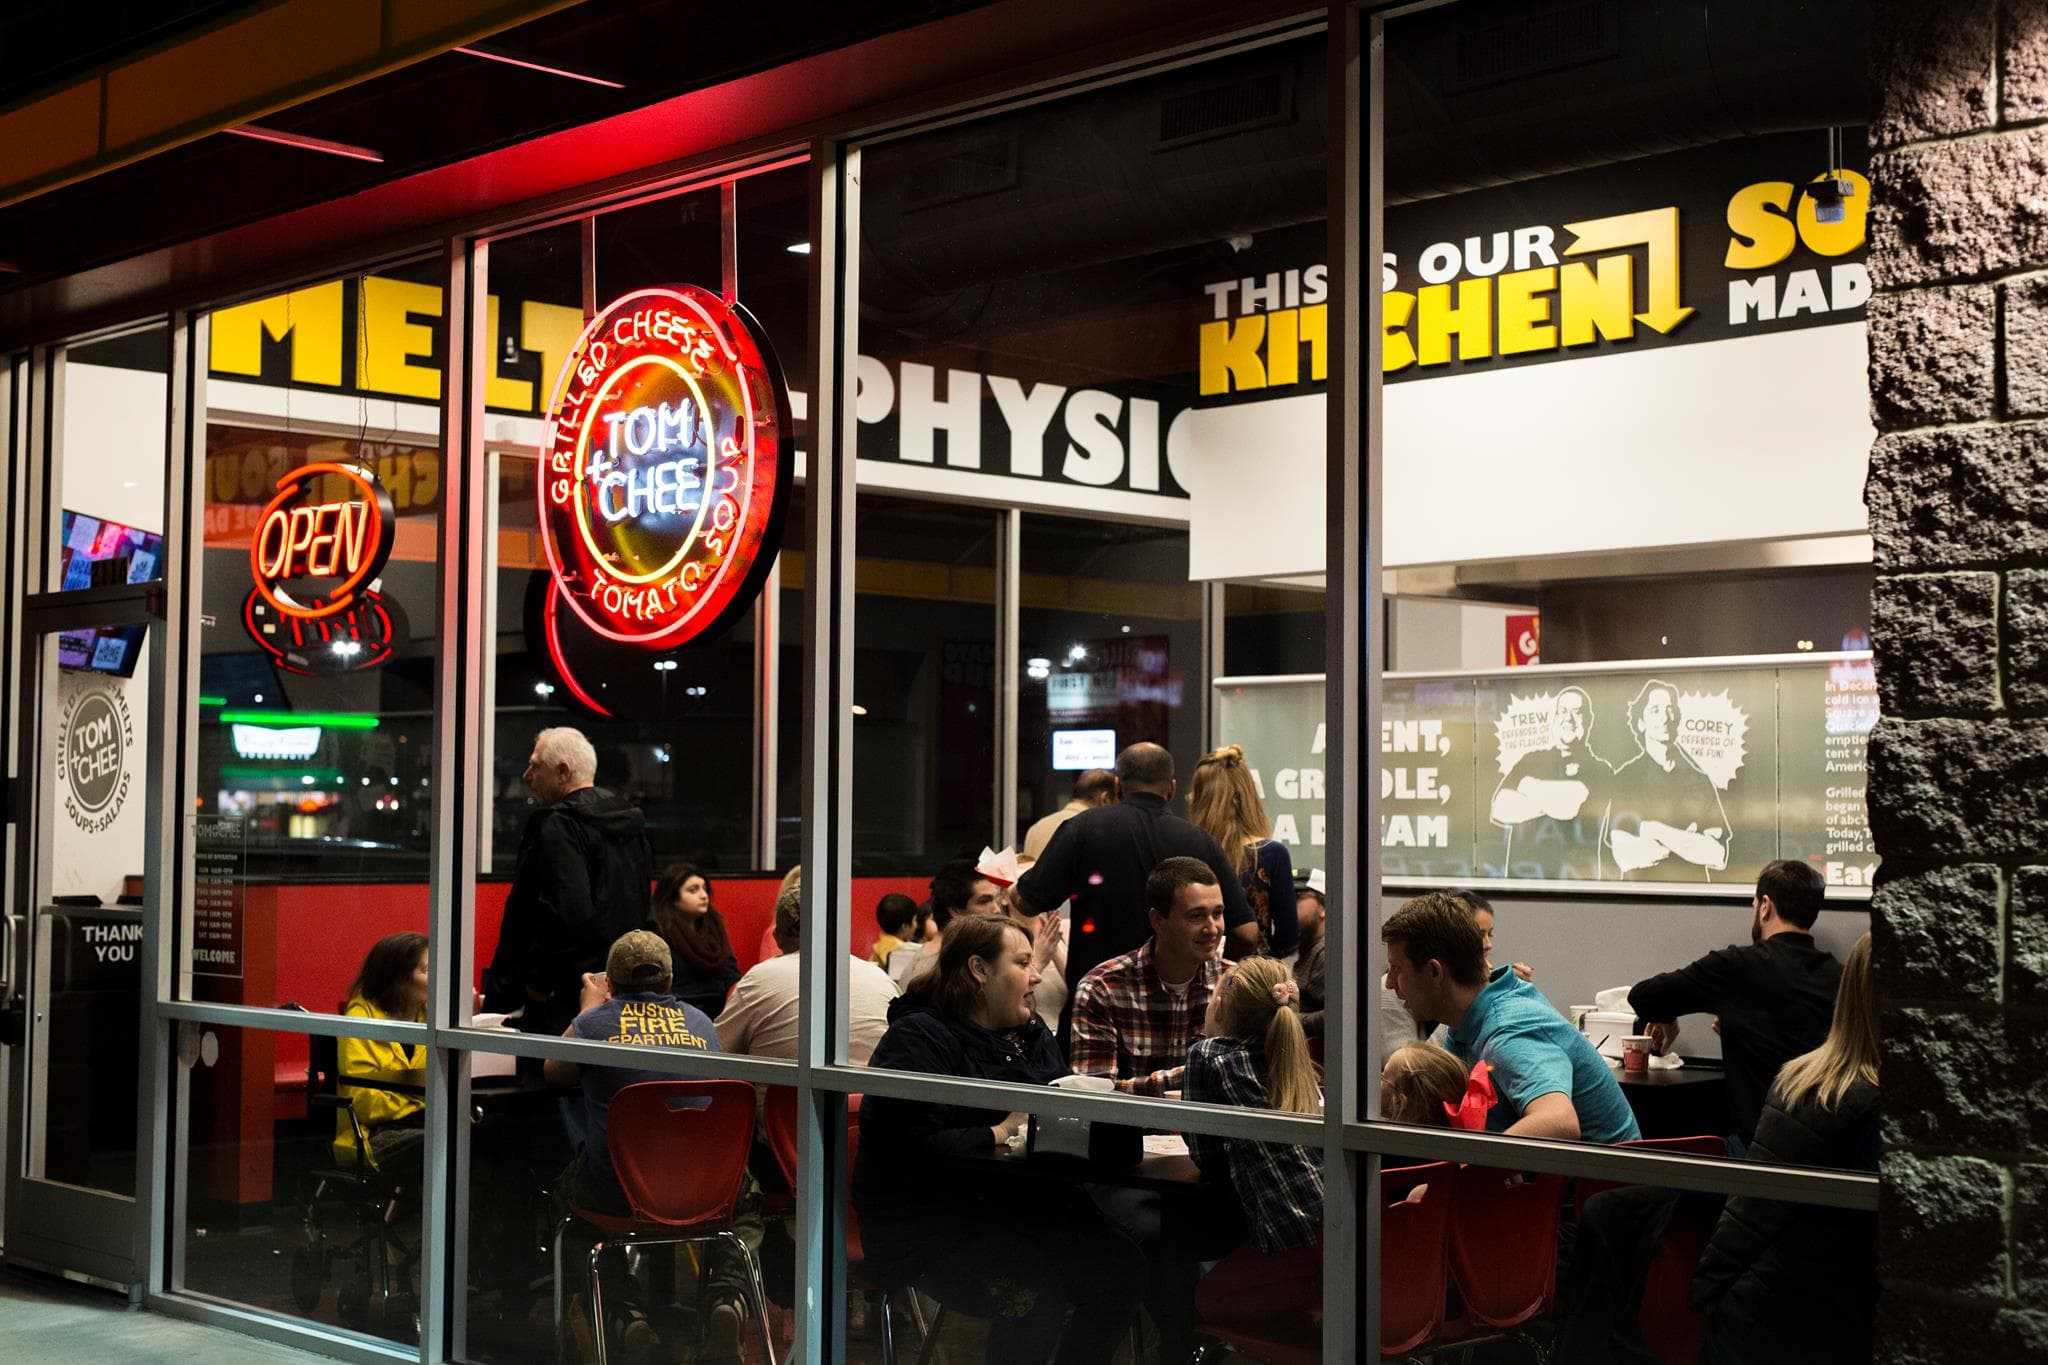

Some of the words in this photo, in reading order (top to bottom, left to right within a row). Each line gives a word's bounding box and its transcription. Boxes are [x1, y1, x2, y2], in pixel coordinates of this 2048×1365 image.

[1204, 264, 1328, 319] THIS
[1418, 225, 1559, 284] OUR
[1200, 254, 1633, 396] KITCHEN
[551, 341, 607, 504] GRILLED
[614, 309, 715, 373] CHEESE
[602, 398, 693, 460] TOM
[591, 562, 700, 621] TOMATO
[705, 437, 741, 557] SOUP
[258, 501, 370, 578] OPEN
[1825, 693, 1849, 705] cold
[1510, 711, 1549, 728] TREW
[1685, 719, 1734, 735] COREY
[57, 694, 77, 780] GRILLED
[76, 713, 112, 754] TOM
[1681, 735, 1721, 746] DEFENDER
[1723, 737, 1735, 748] OF
[1825, 749, 1849, 759] tent
[1825, 787, 1866, 799] Grilled
[1825, 800, 1860, 815] began
[1826, 814, 1838, 826] of
[1272, 814, 1301, 846] A
[1825, 841, 1863, 855] grilled
[81, 924, 143, 943] THANK
[95, 945, 134, 962] YOU
[192, 948, 236, 964] WELCOME
[620, 1003, 684, 1018] AUSTIN
[619, 1016, 689, 1035] FIRE
[607, 1033, 708, 1050] EPARTMENT
